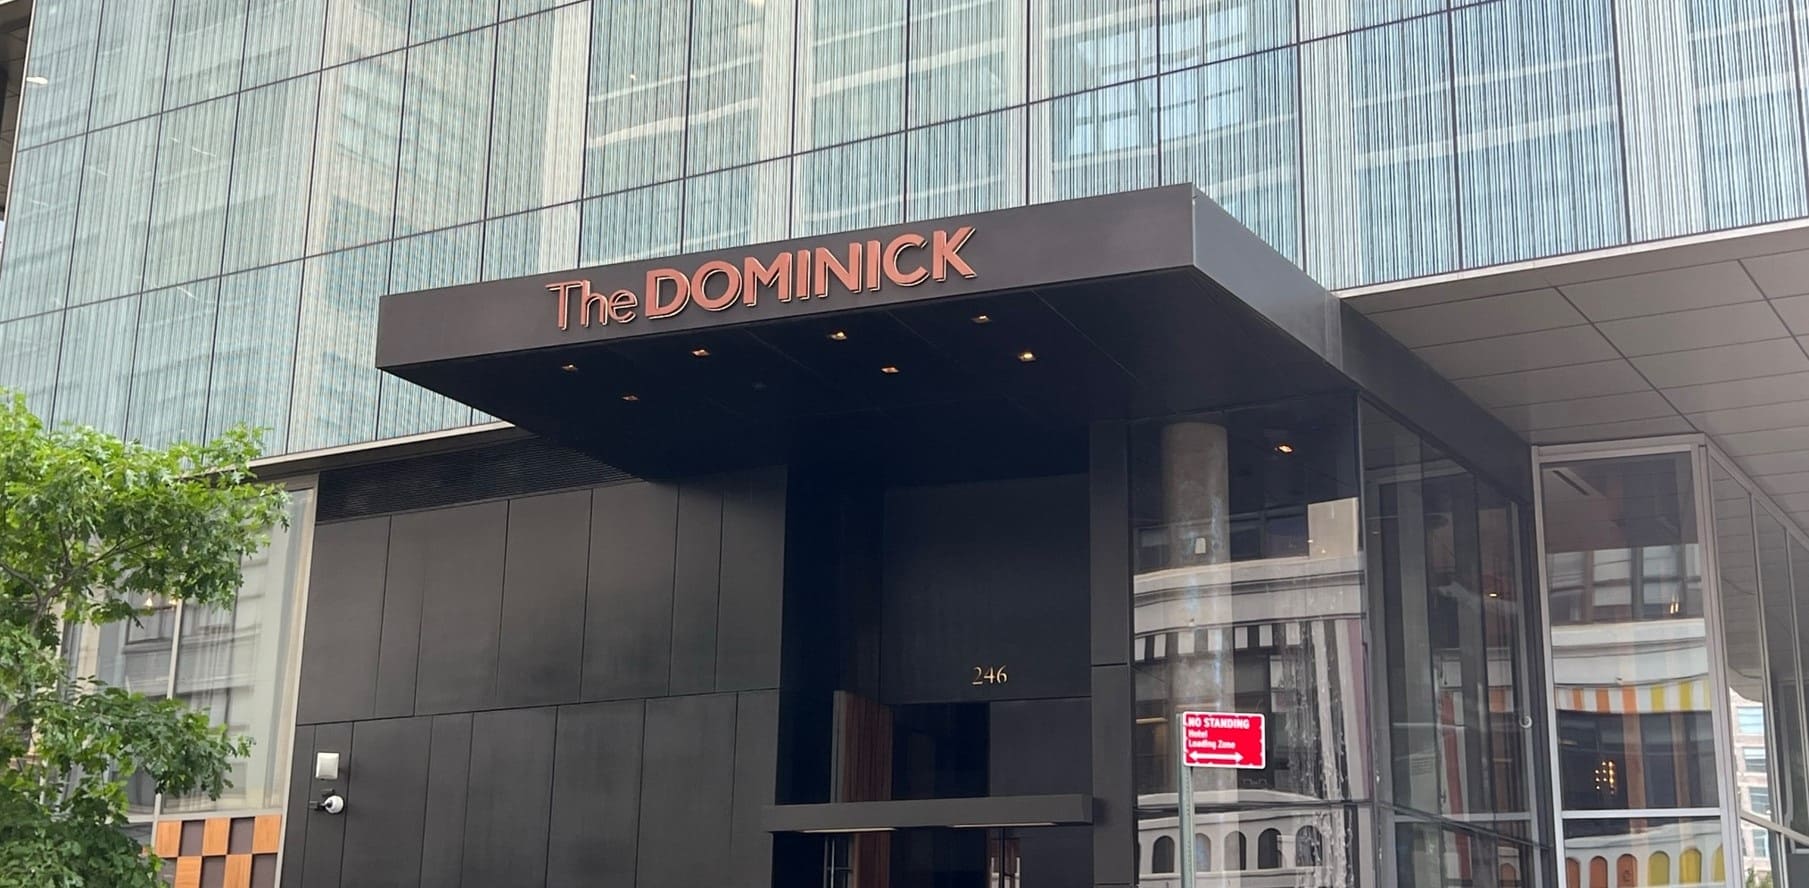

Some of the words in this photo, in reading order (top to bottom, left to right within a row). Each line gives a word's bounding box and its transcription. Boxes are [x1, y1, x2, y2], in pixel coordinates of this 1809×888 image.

[545, 279, 638, 331] The
[646, 226, 977, 319] DOMINICK
[972, 664, 1008, 685] 246
[1188, 717, 1202, 727] NO
[1204, 718, 1250, 729] STANDING
[1188, 730, 1208, 738] Hotel
[1188, 740, 1217, 750] Loading
[1218, 740, 1236, 749] Zone
